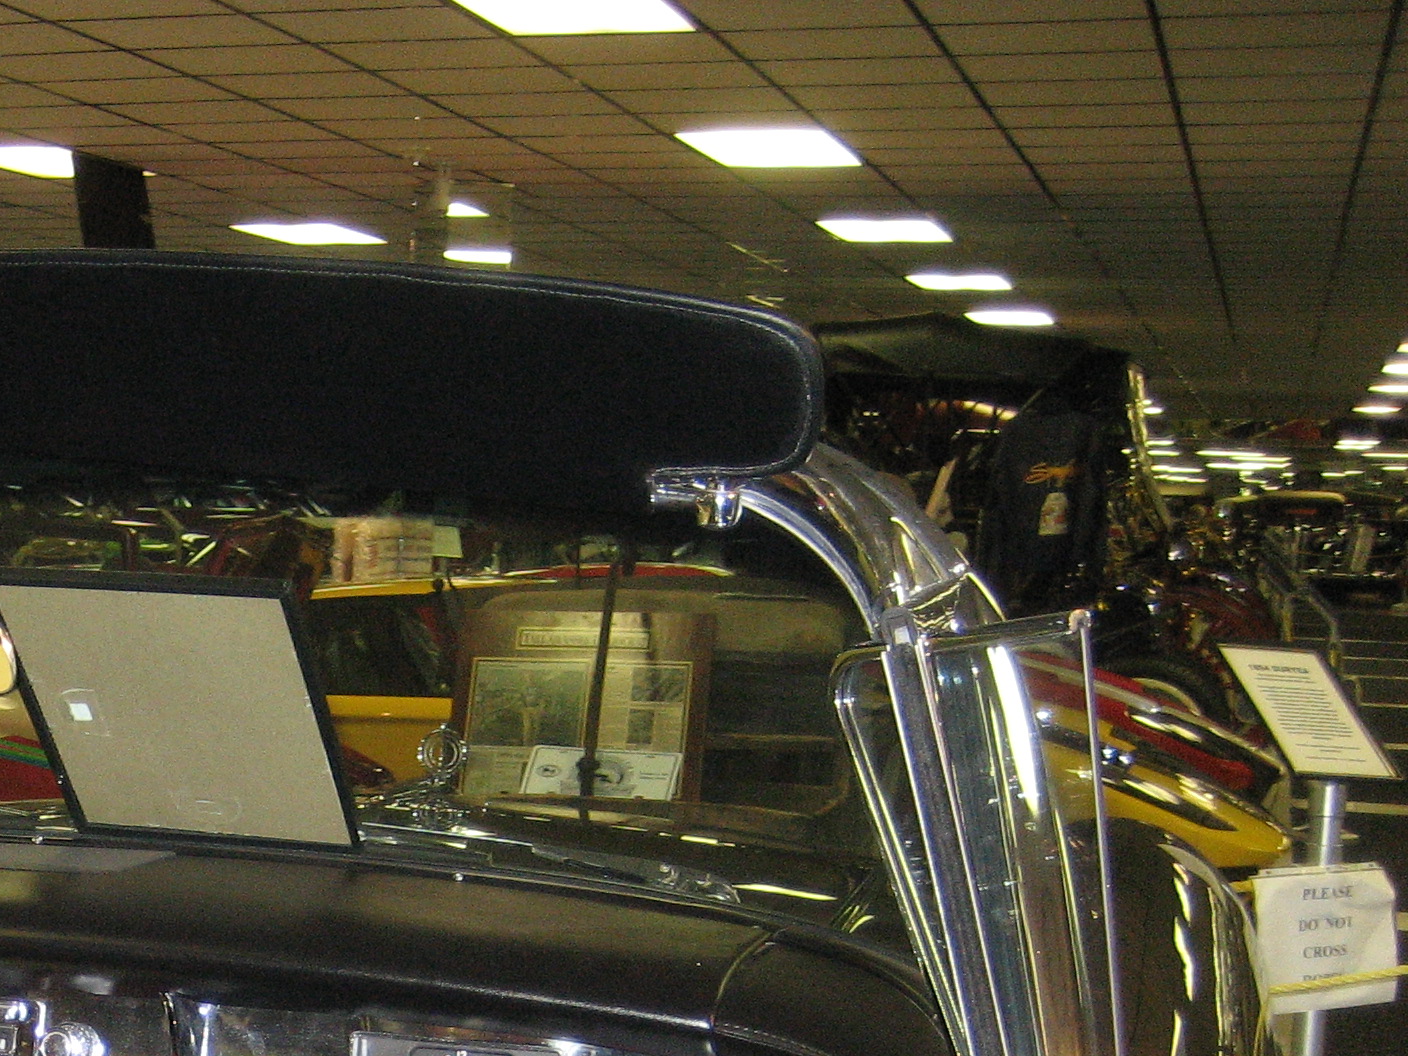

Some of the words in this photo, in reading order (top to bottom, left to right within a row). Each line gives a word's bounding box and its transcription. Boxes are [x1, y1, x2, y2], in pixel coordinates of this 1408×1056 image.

[1302, 886, 1353, 900] PLEASE
[1299, 919, 1318, 932] DO
[1325, 917, 1352, 929] NOT
[1303, 945, 1347, 959] CROSS
